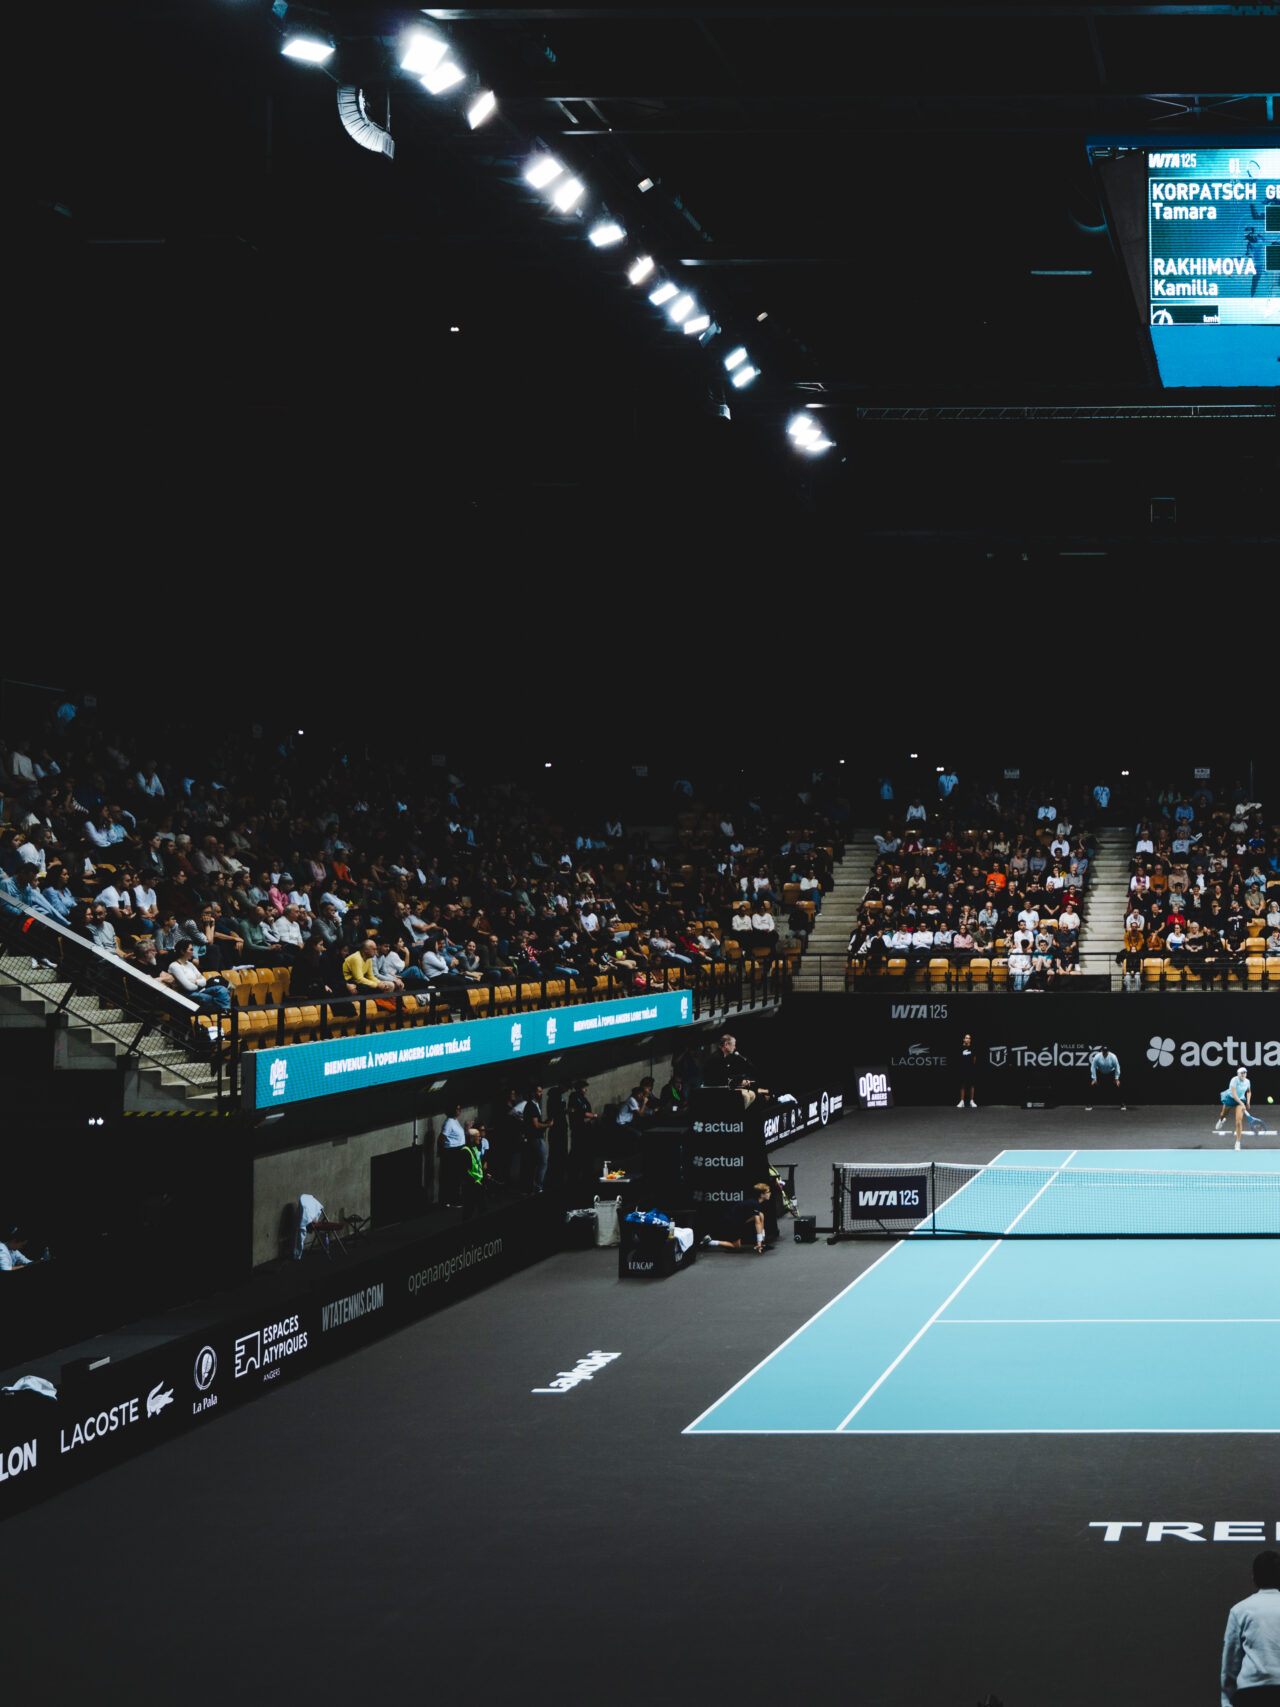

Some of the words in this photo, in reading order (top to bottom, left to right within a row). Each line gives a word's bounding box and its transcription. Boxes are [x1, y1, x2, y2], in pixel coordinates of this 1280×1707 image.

[1148, 153, 1180, 168] WTA
[1181, 153, 1197, 168] 125
[1152, 183, 1257, 200] KORPATSCH
[1152, 202, 1217, 220] Tamara
[1153, 257, 1257, 275] RAKHIMOVA
[1154, 279, 1219, 296] Kamilla
[891, 1004, 927, 1019] WTA
[930, 1004, 948, 1018] 125
[324, 1055, 367, 1076] BIENVENUE
[891, 1056, 947, 1066] LACOSTE
[704, 1122, 744, 1133] actual
[704, 1156, 744, 1167] actual
[705, 1190, 744, 1202] actual
[859, 1190, 898, 1206] WTA
[899, 1190, 920, 1206] 125
[408, 1237, 503, 1293] openangersloire.com
[322, 1283, 384, 1332] WTATENNIS.COM
[263, 1315, 299, 1344] ESPACES
[263, 1332, 308, 1366] ATYPIQUES
[193, 1402, 202, 1414] La
[203, 1394, 218, 1410] Pala
[61, 1398, 139, 1453] LACOSTE
